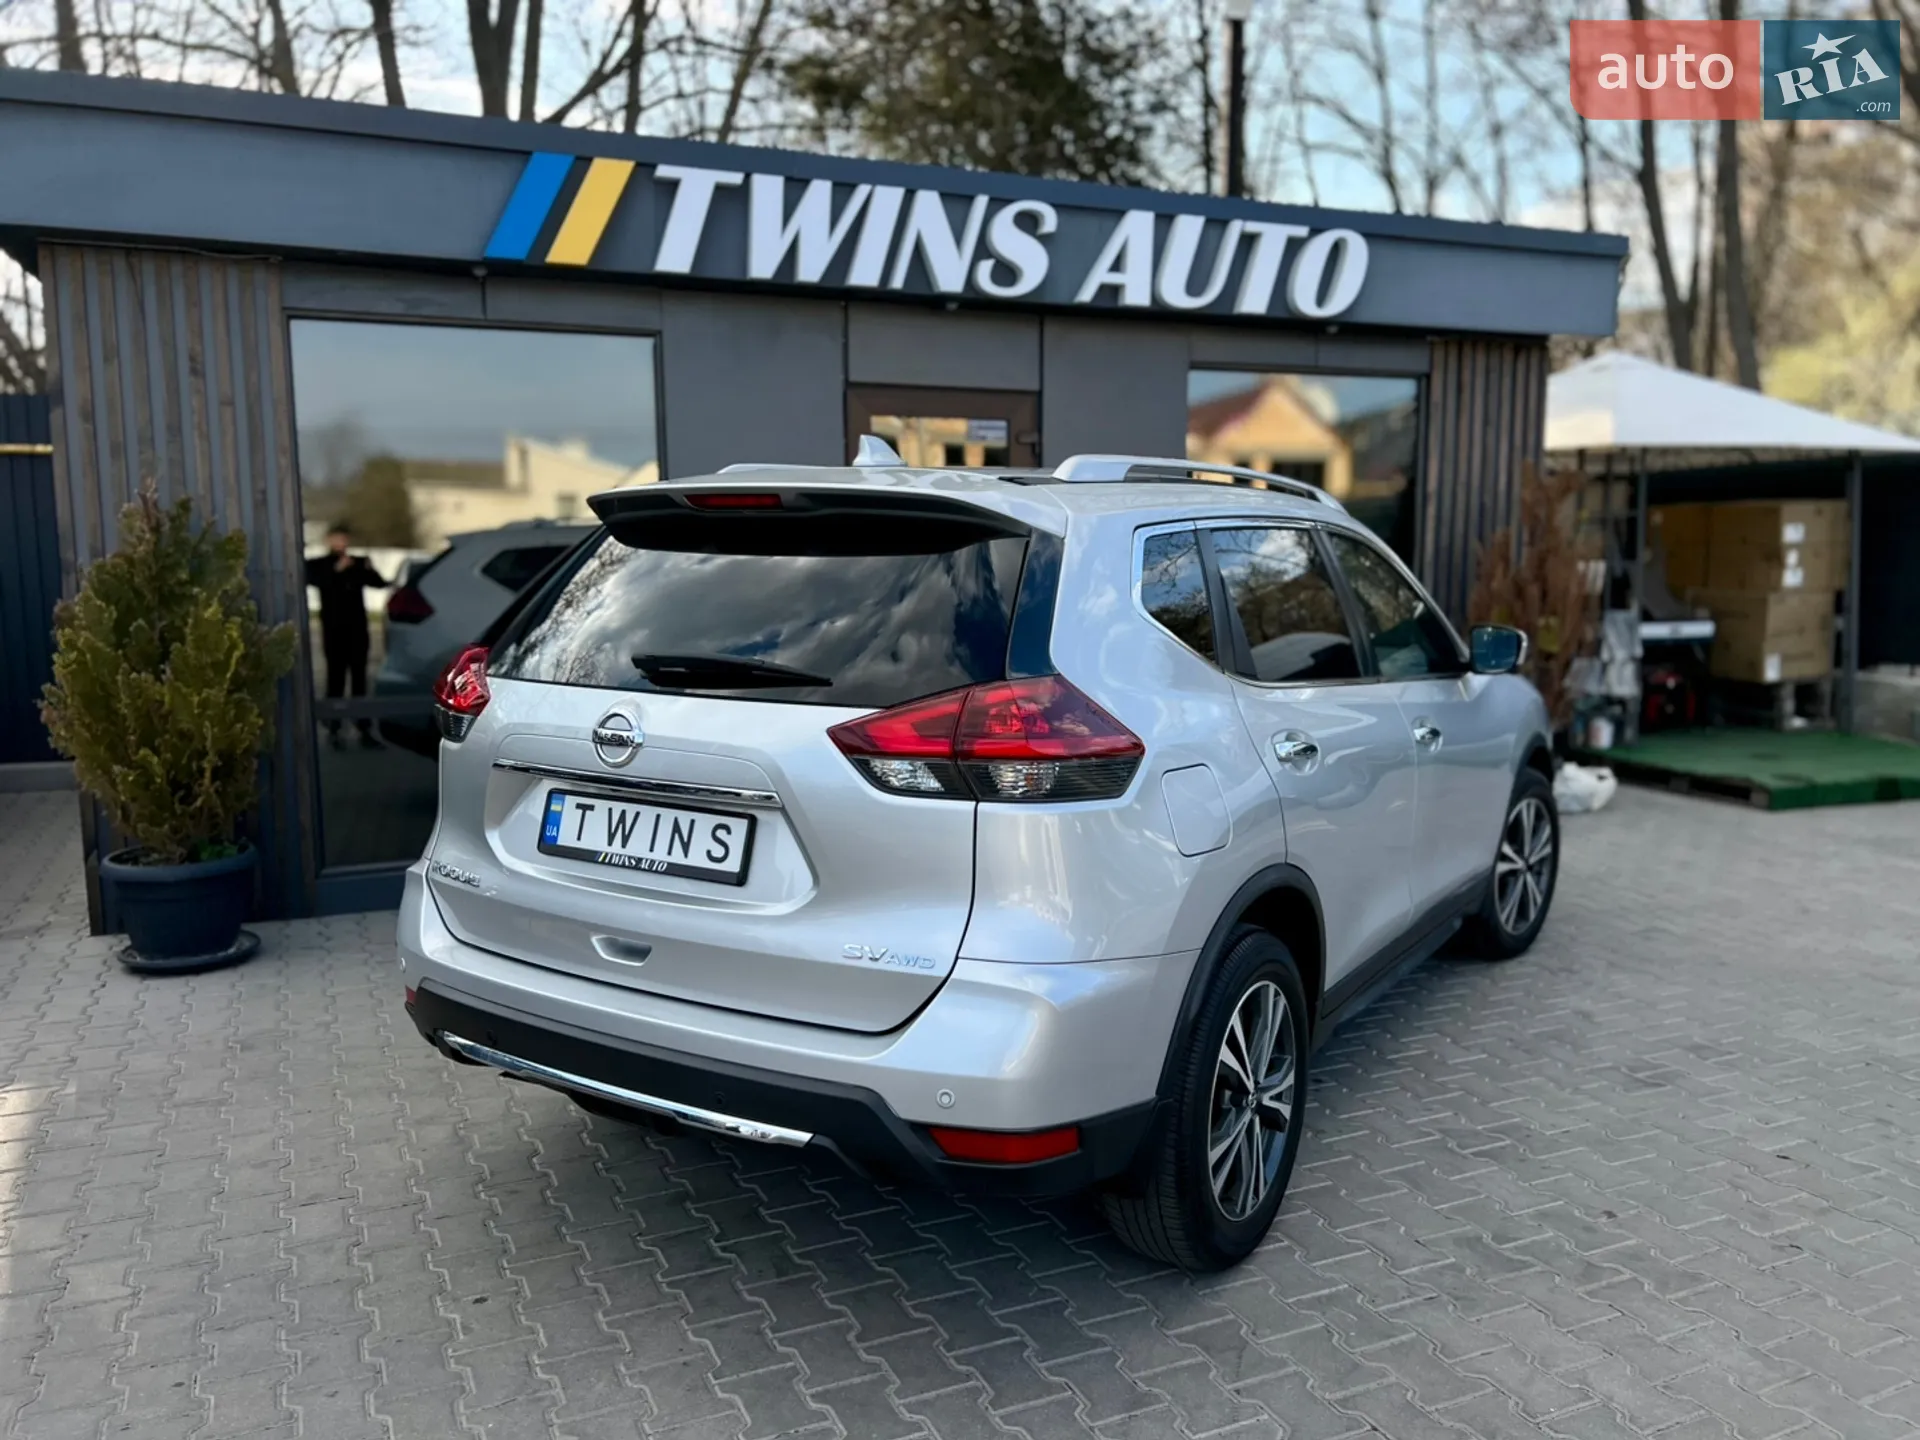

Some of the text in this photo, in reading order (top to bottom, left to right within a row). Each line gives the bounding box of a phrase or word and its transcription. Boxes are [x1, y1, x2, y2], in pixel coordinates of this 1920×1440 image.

[653, 164, 1371, 318] TWINS AUTO
[593, 729, 636, 746] NISSAN
[545, 824, 558, 837] UA
[575, 803, 732, 863] TWINS
[604, 852, 668, 872] TWINS AUTO
[842, 943, 936, 969] SV AWD
